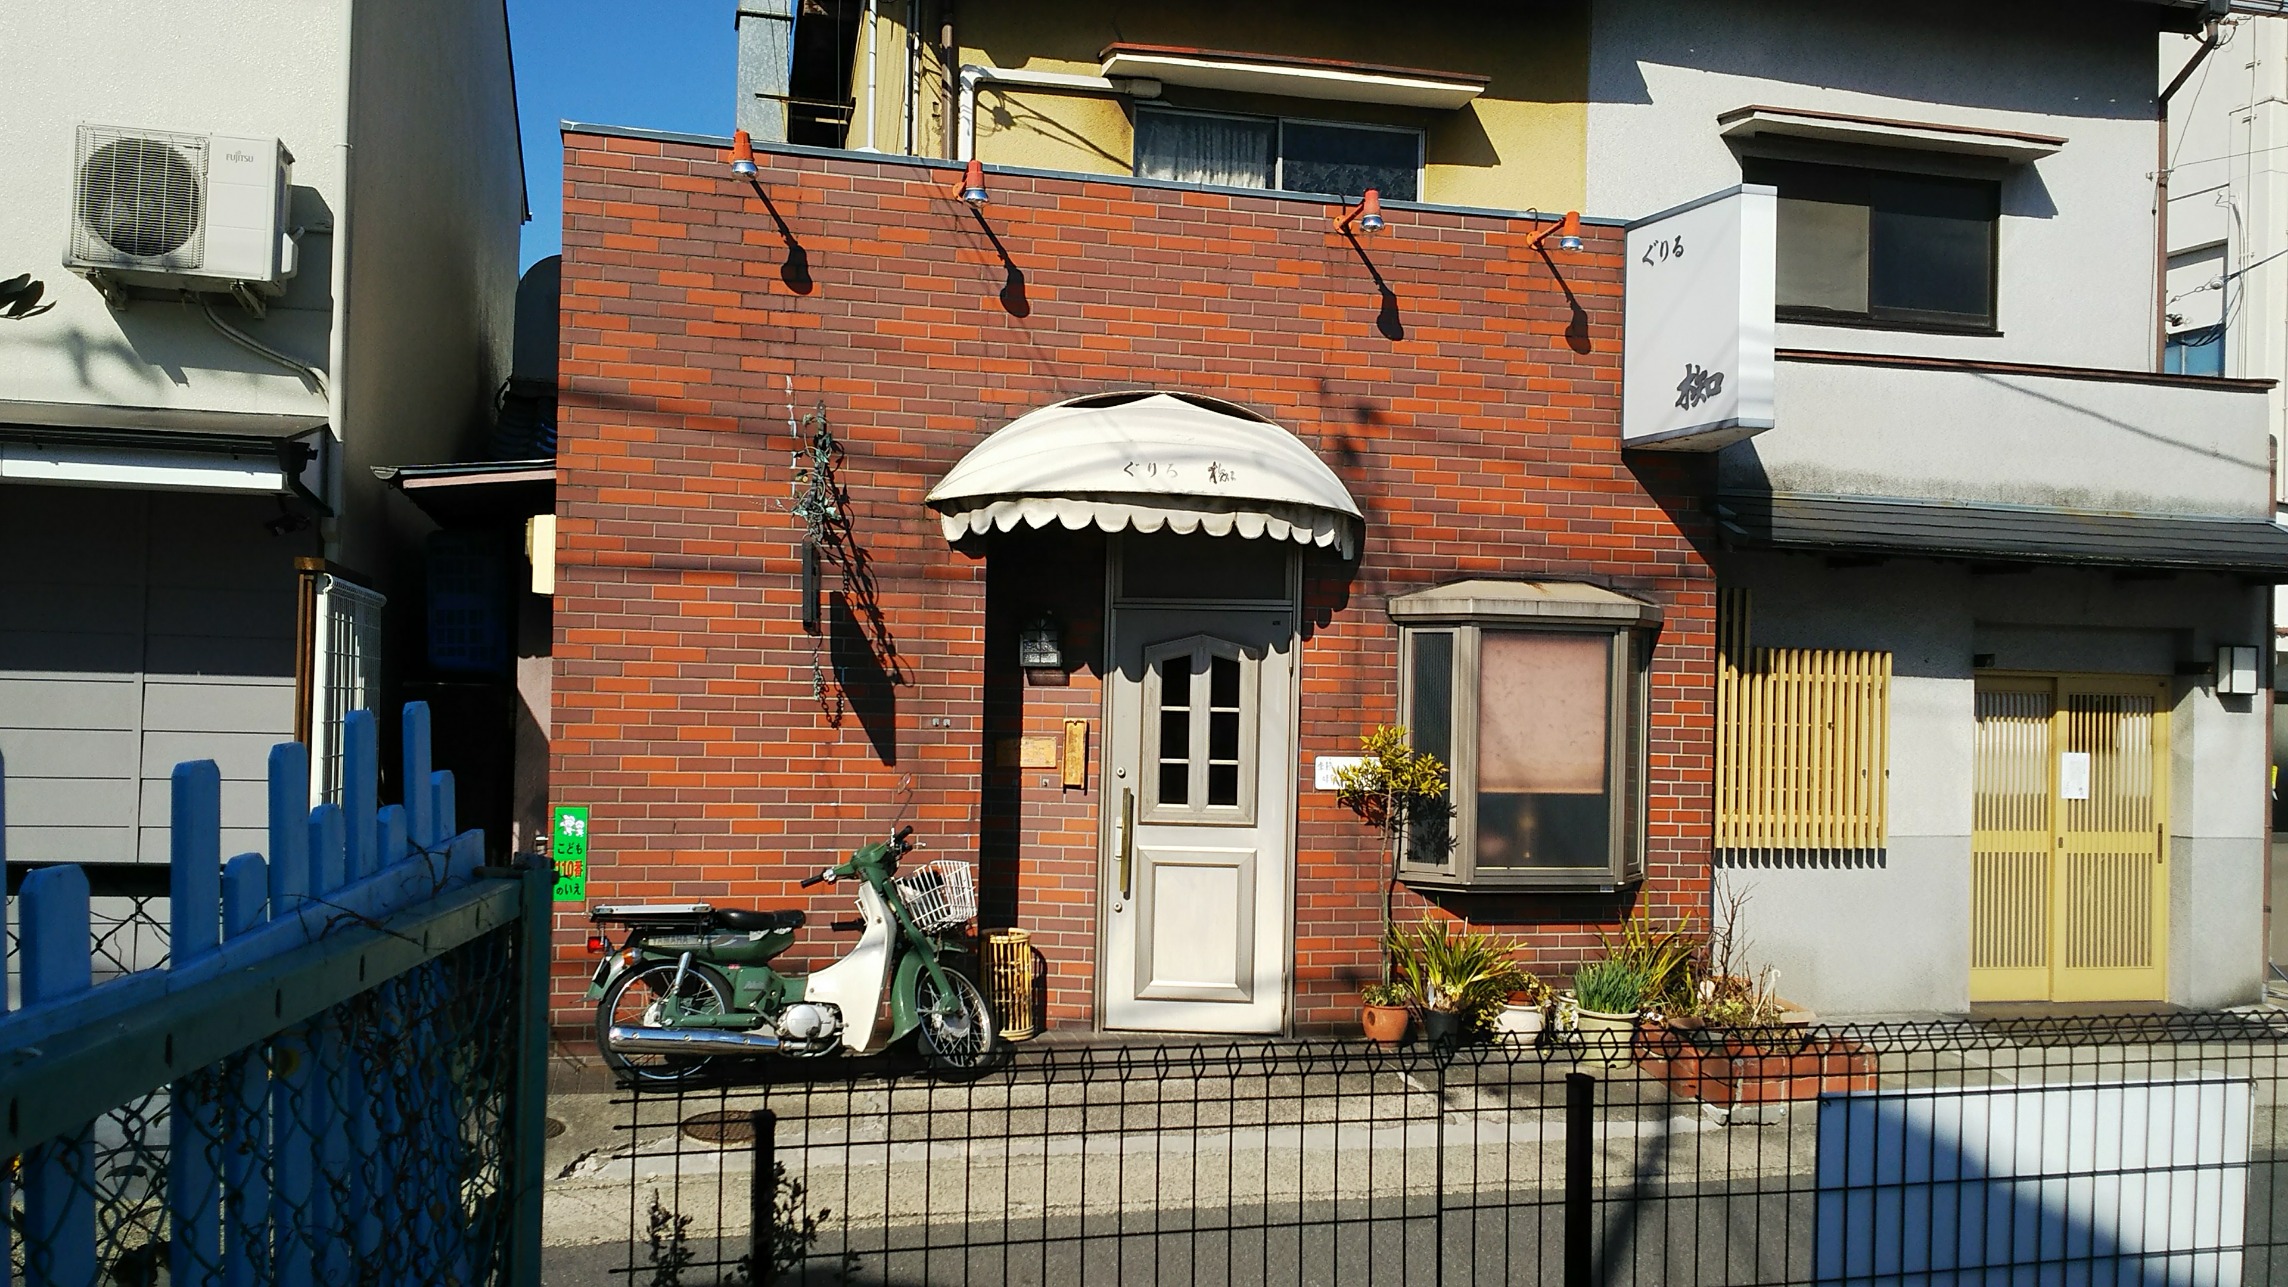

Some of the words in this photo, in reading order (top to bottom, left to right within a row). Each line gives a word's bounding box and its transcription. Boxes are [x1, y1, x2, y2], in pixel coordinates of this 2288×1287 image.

[226, 150, 254, 163] FUJITSU
[1641, 235, 1684, 267] ぐりる
[557, 842, 582, 855] こども
[555, 883, 581, 895] のいえ
